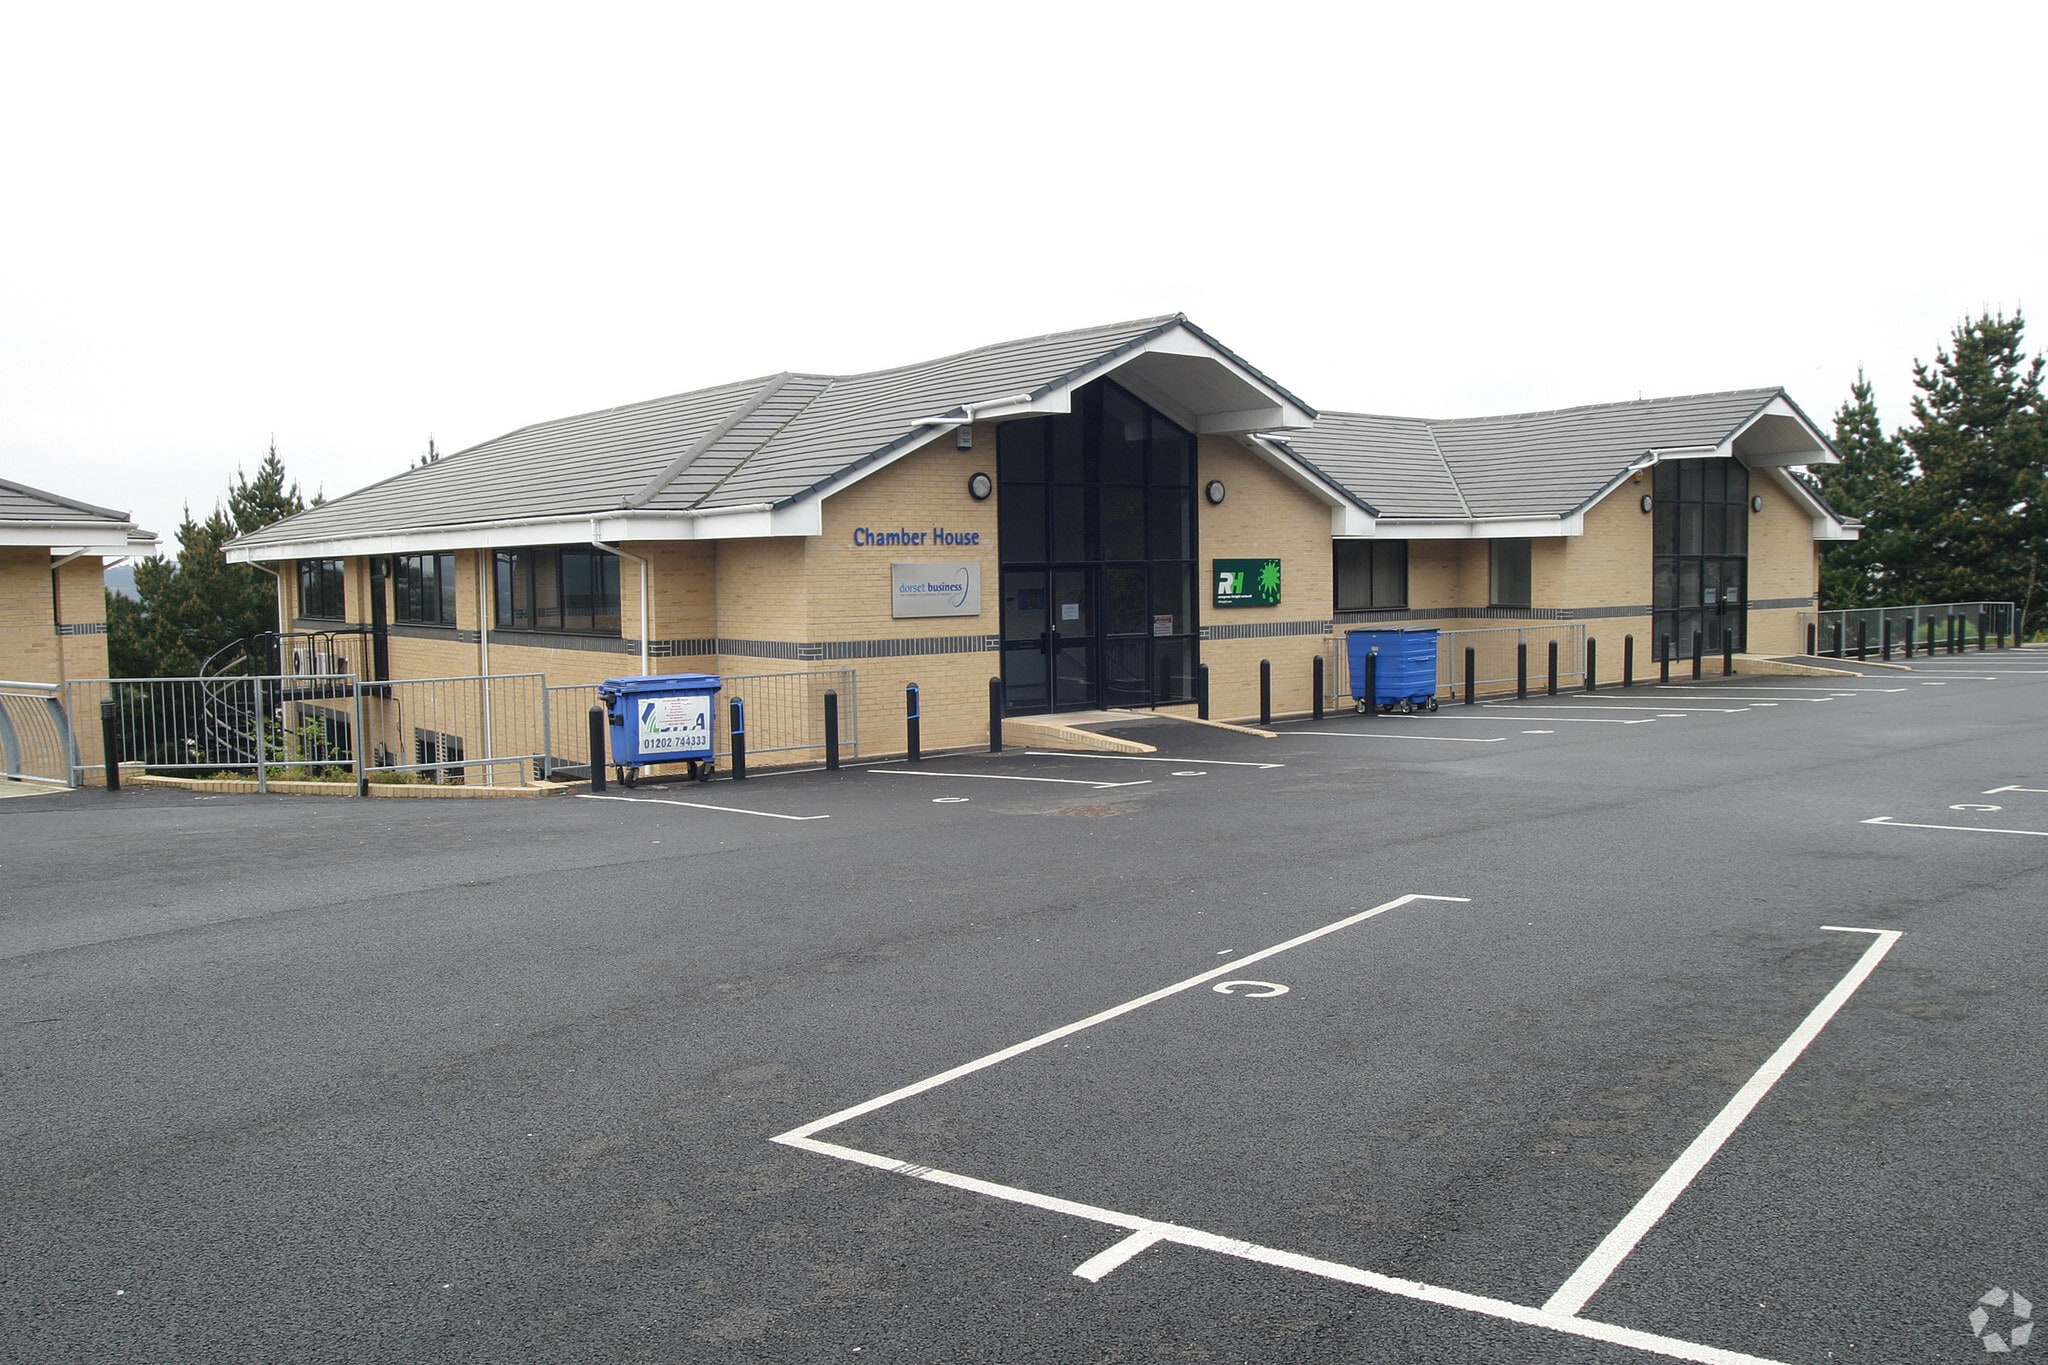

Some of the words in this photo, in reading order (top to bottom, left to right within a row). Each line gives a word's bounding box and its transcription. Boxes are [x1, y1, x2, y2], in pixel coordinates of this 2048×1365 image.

[854, 527, 927, 547] Chamber
[933, 527, 980, 546] House
[899, 583, 925, 593] dorset
[927, 582, 962, 592] business
[644, 738, 672, 749] 01202
[675, 736, 706, 747] 744333
